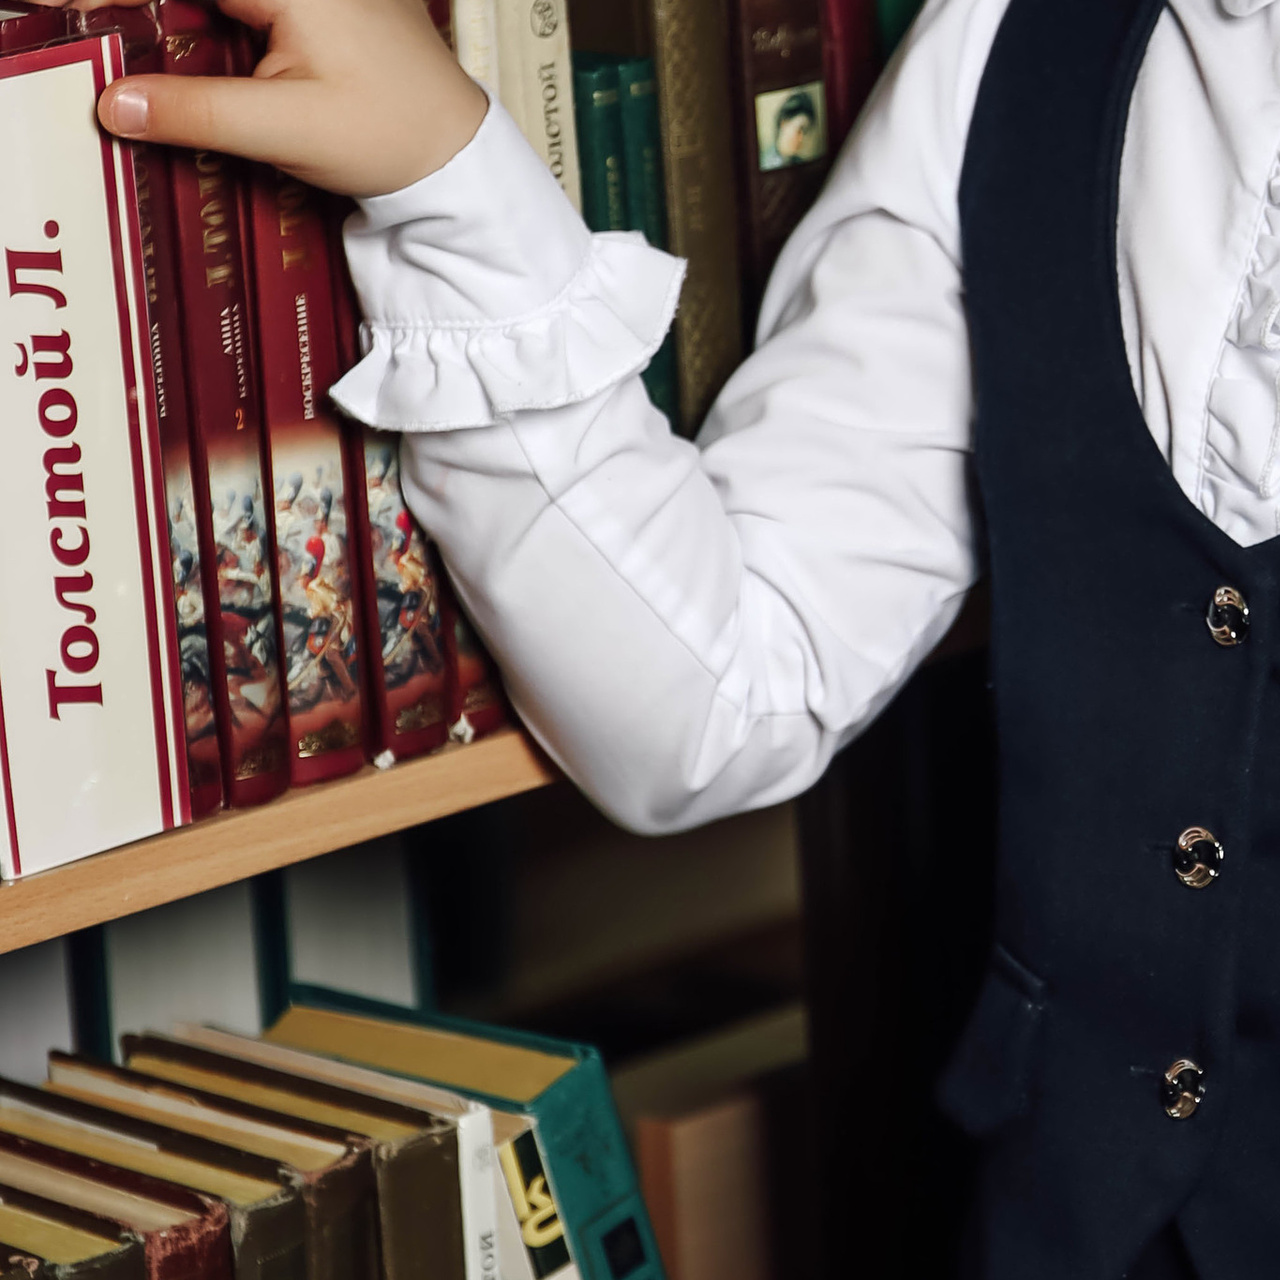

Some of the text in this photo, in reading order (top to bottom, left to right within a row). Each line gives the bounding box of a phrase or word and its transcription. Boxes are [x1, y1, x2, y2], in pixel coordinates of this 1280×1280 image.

[537, 61, 566, 191] ОЛСТОЙ
[235, 407, 245, 431] 2
[294, 292, 316, 421] ВОСКРЕСЕНИЕ
[5, 218, 105, 721] Толстой Л.
